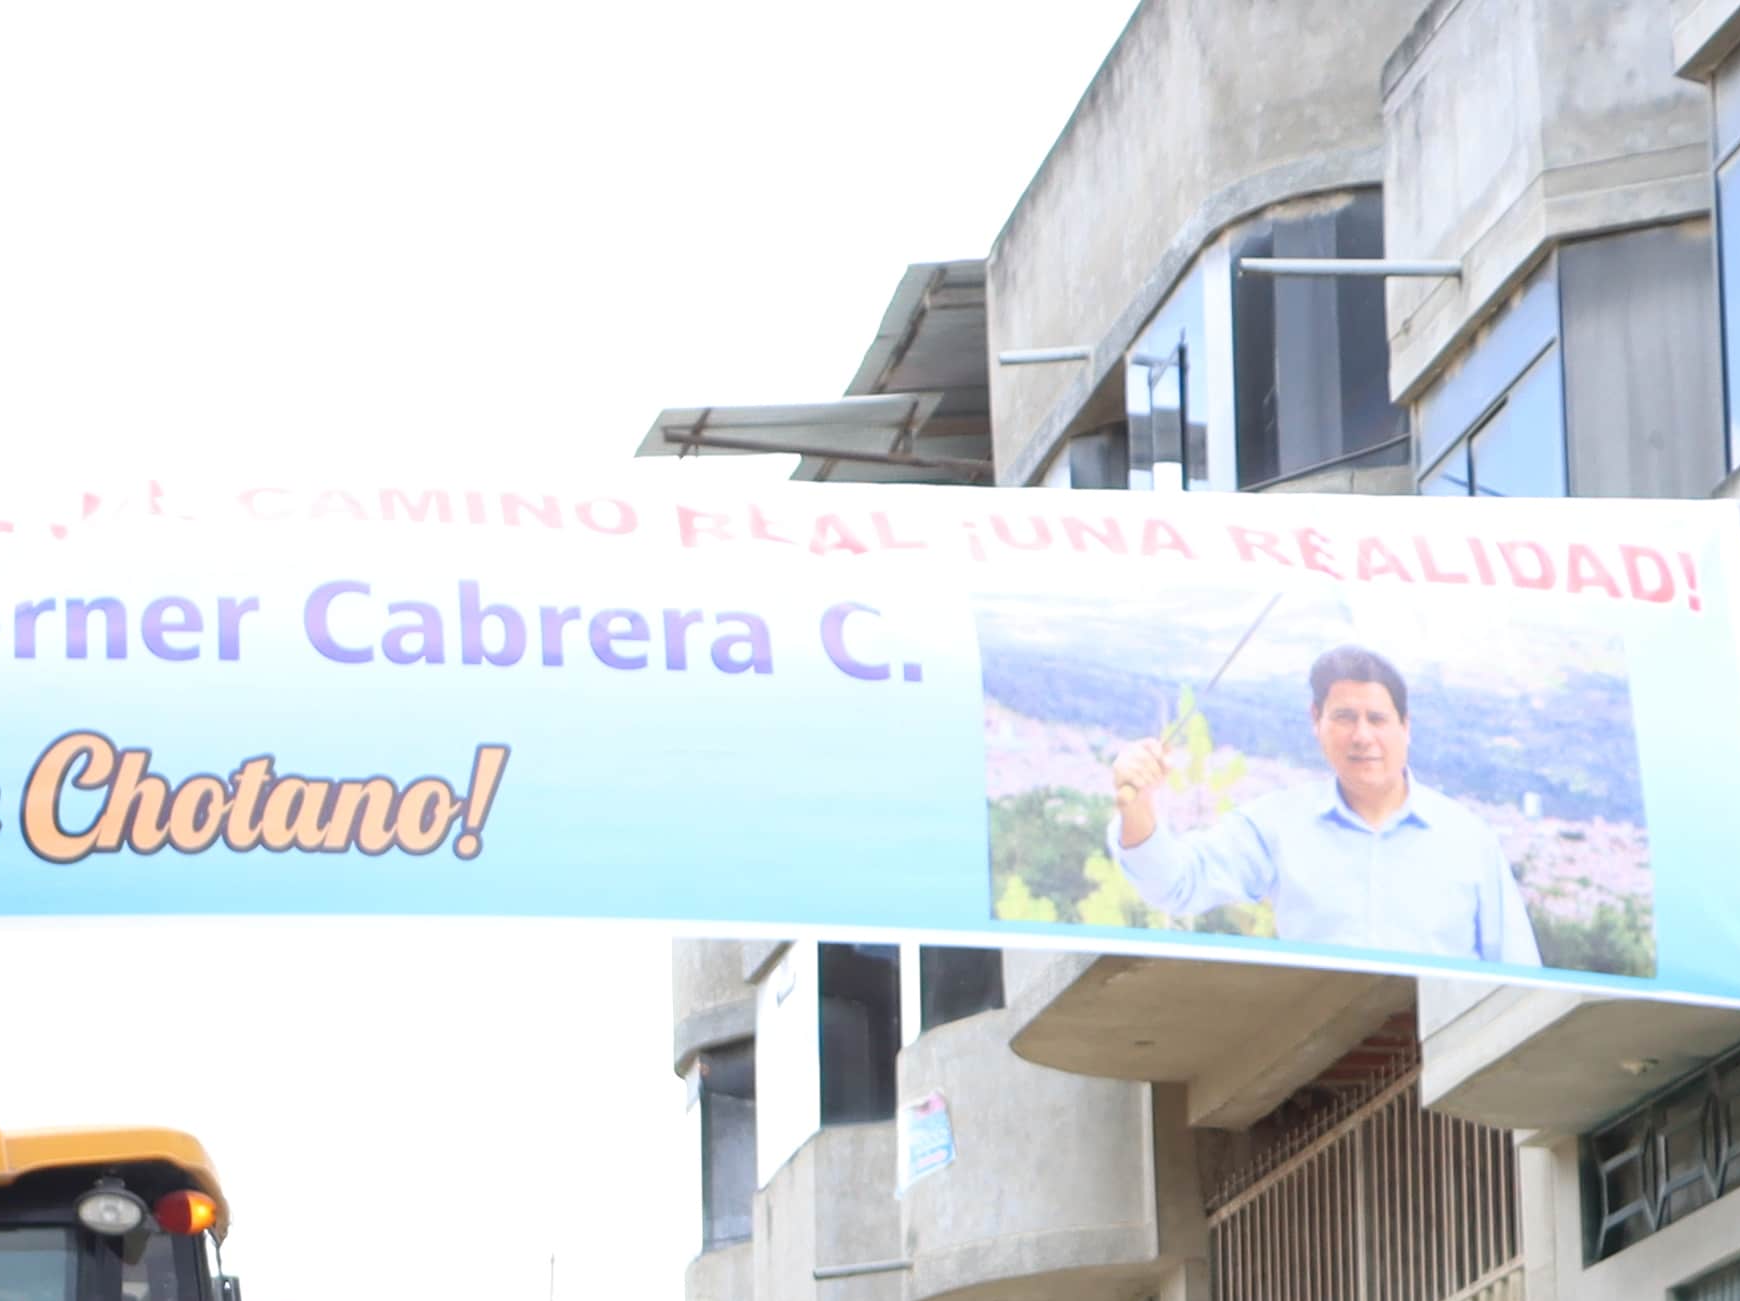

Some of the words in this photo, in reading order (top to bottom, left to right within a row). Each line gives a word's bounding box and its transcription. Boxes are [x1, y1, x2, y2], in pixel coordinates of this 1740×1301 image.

[238, 484, 640, 536] CAMINO
[677, 501, 928, 557] REAL
[1228, 523, 1704, 612] REALIDAD!
[303, 579, 775, 676] Cabrera
[819, 601, 924, 684] C.
[20, 730, 511, 863] Chotano!
